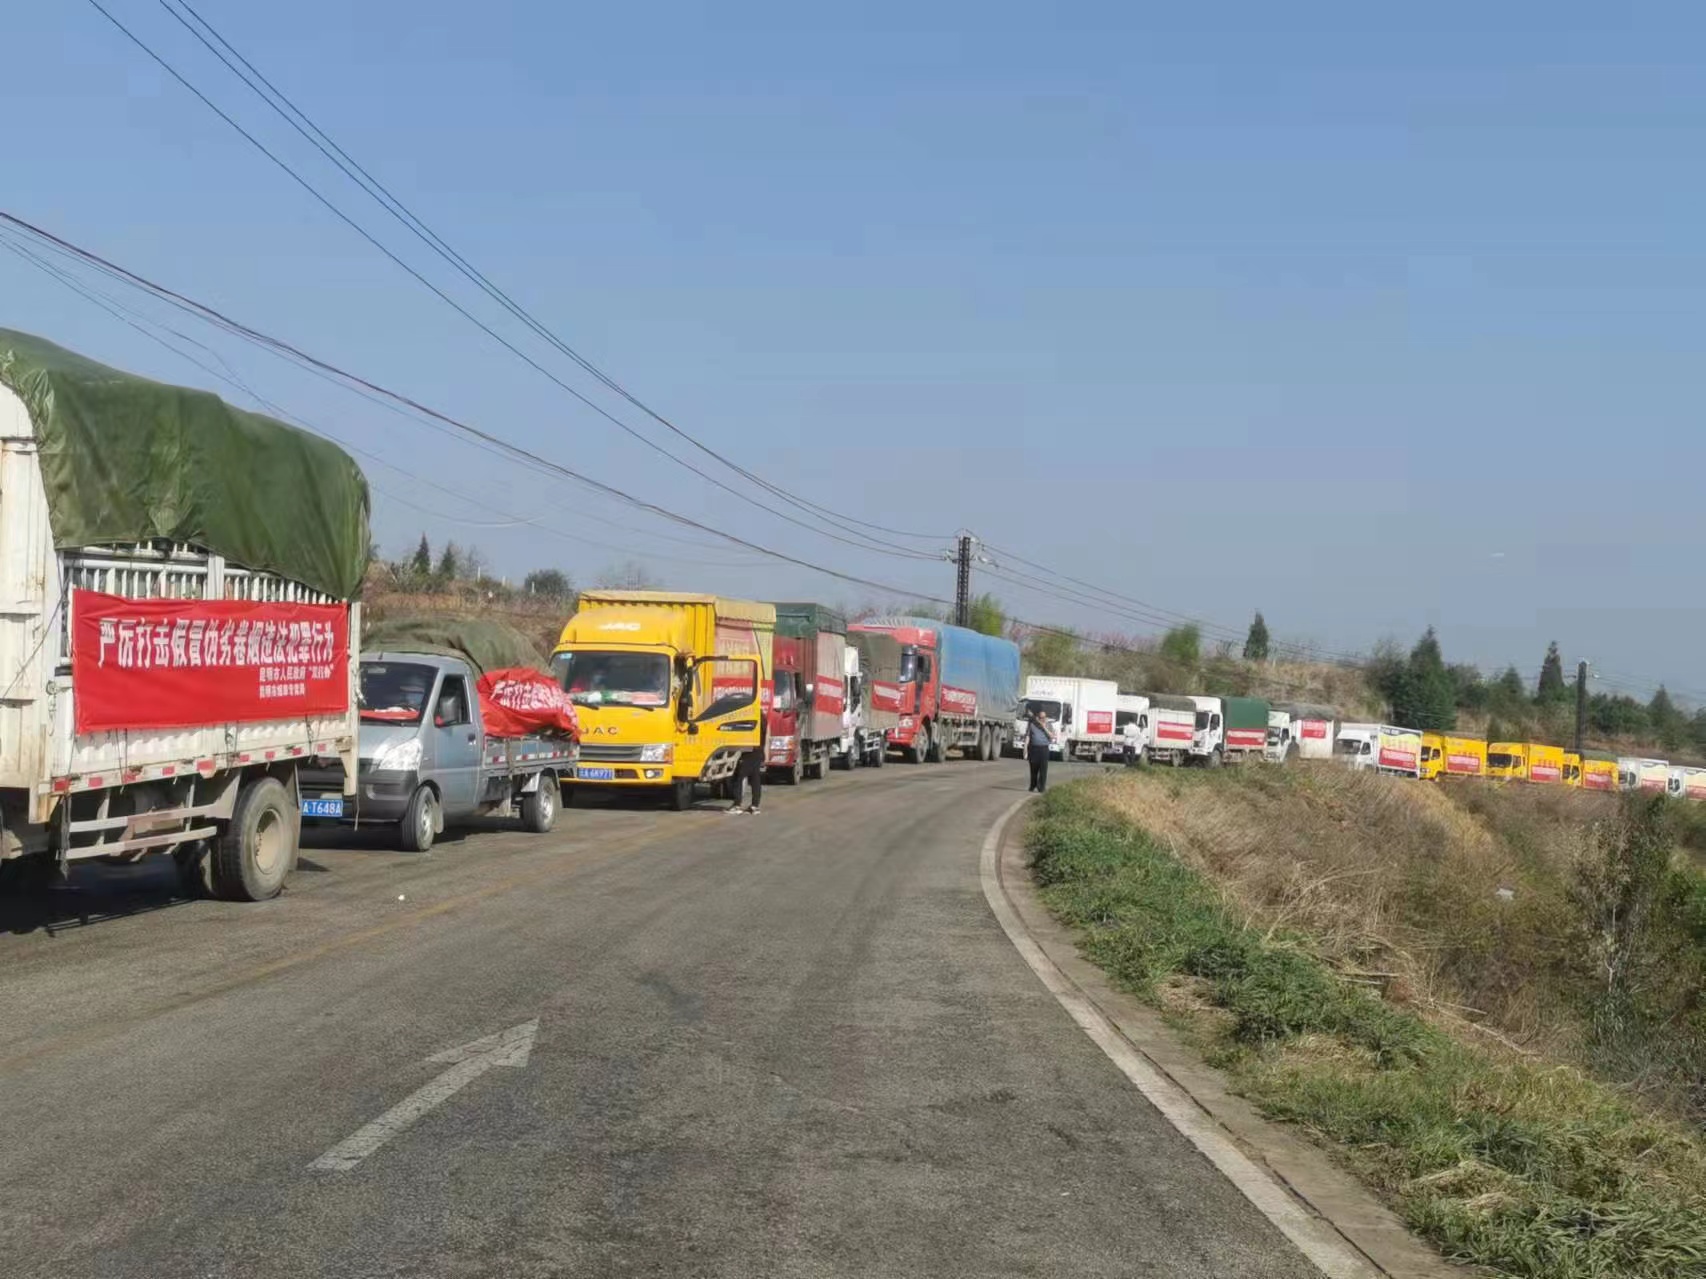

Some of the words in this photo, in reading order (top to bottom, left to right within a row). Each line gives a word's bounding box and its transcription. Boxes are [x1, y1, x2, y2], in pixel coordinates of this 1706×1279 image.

[98, 617, 334, 668] 严厉打击假冒伪劣卷烟违法犯罪行为
[582, 726, 618, 736] JAC
